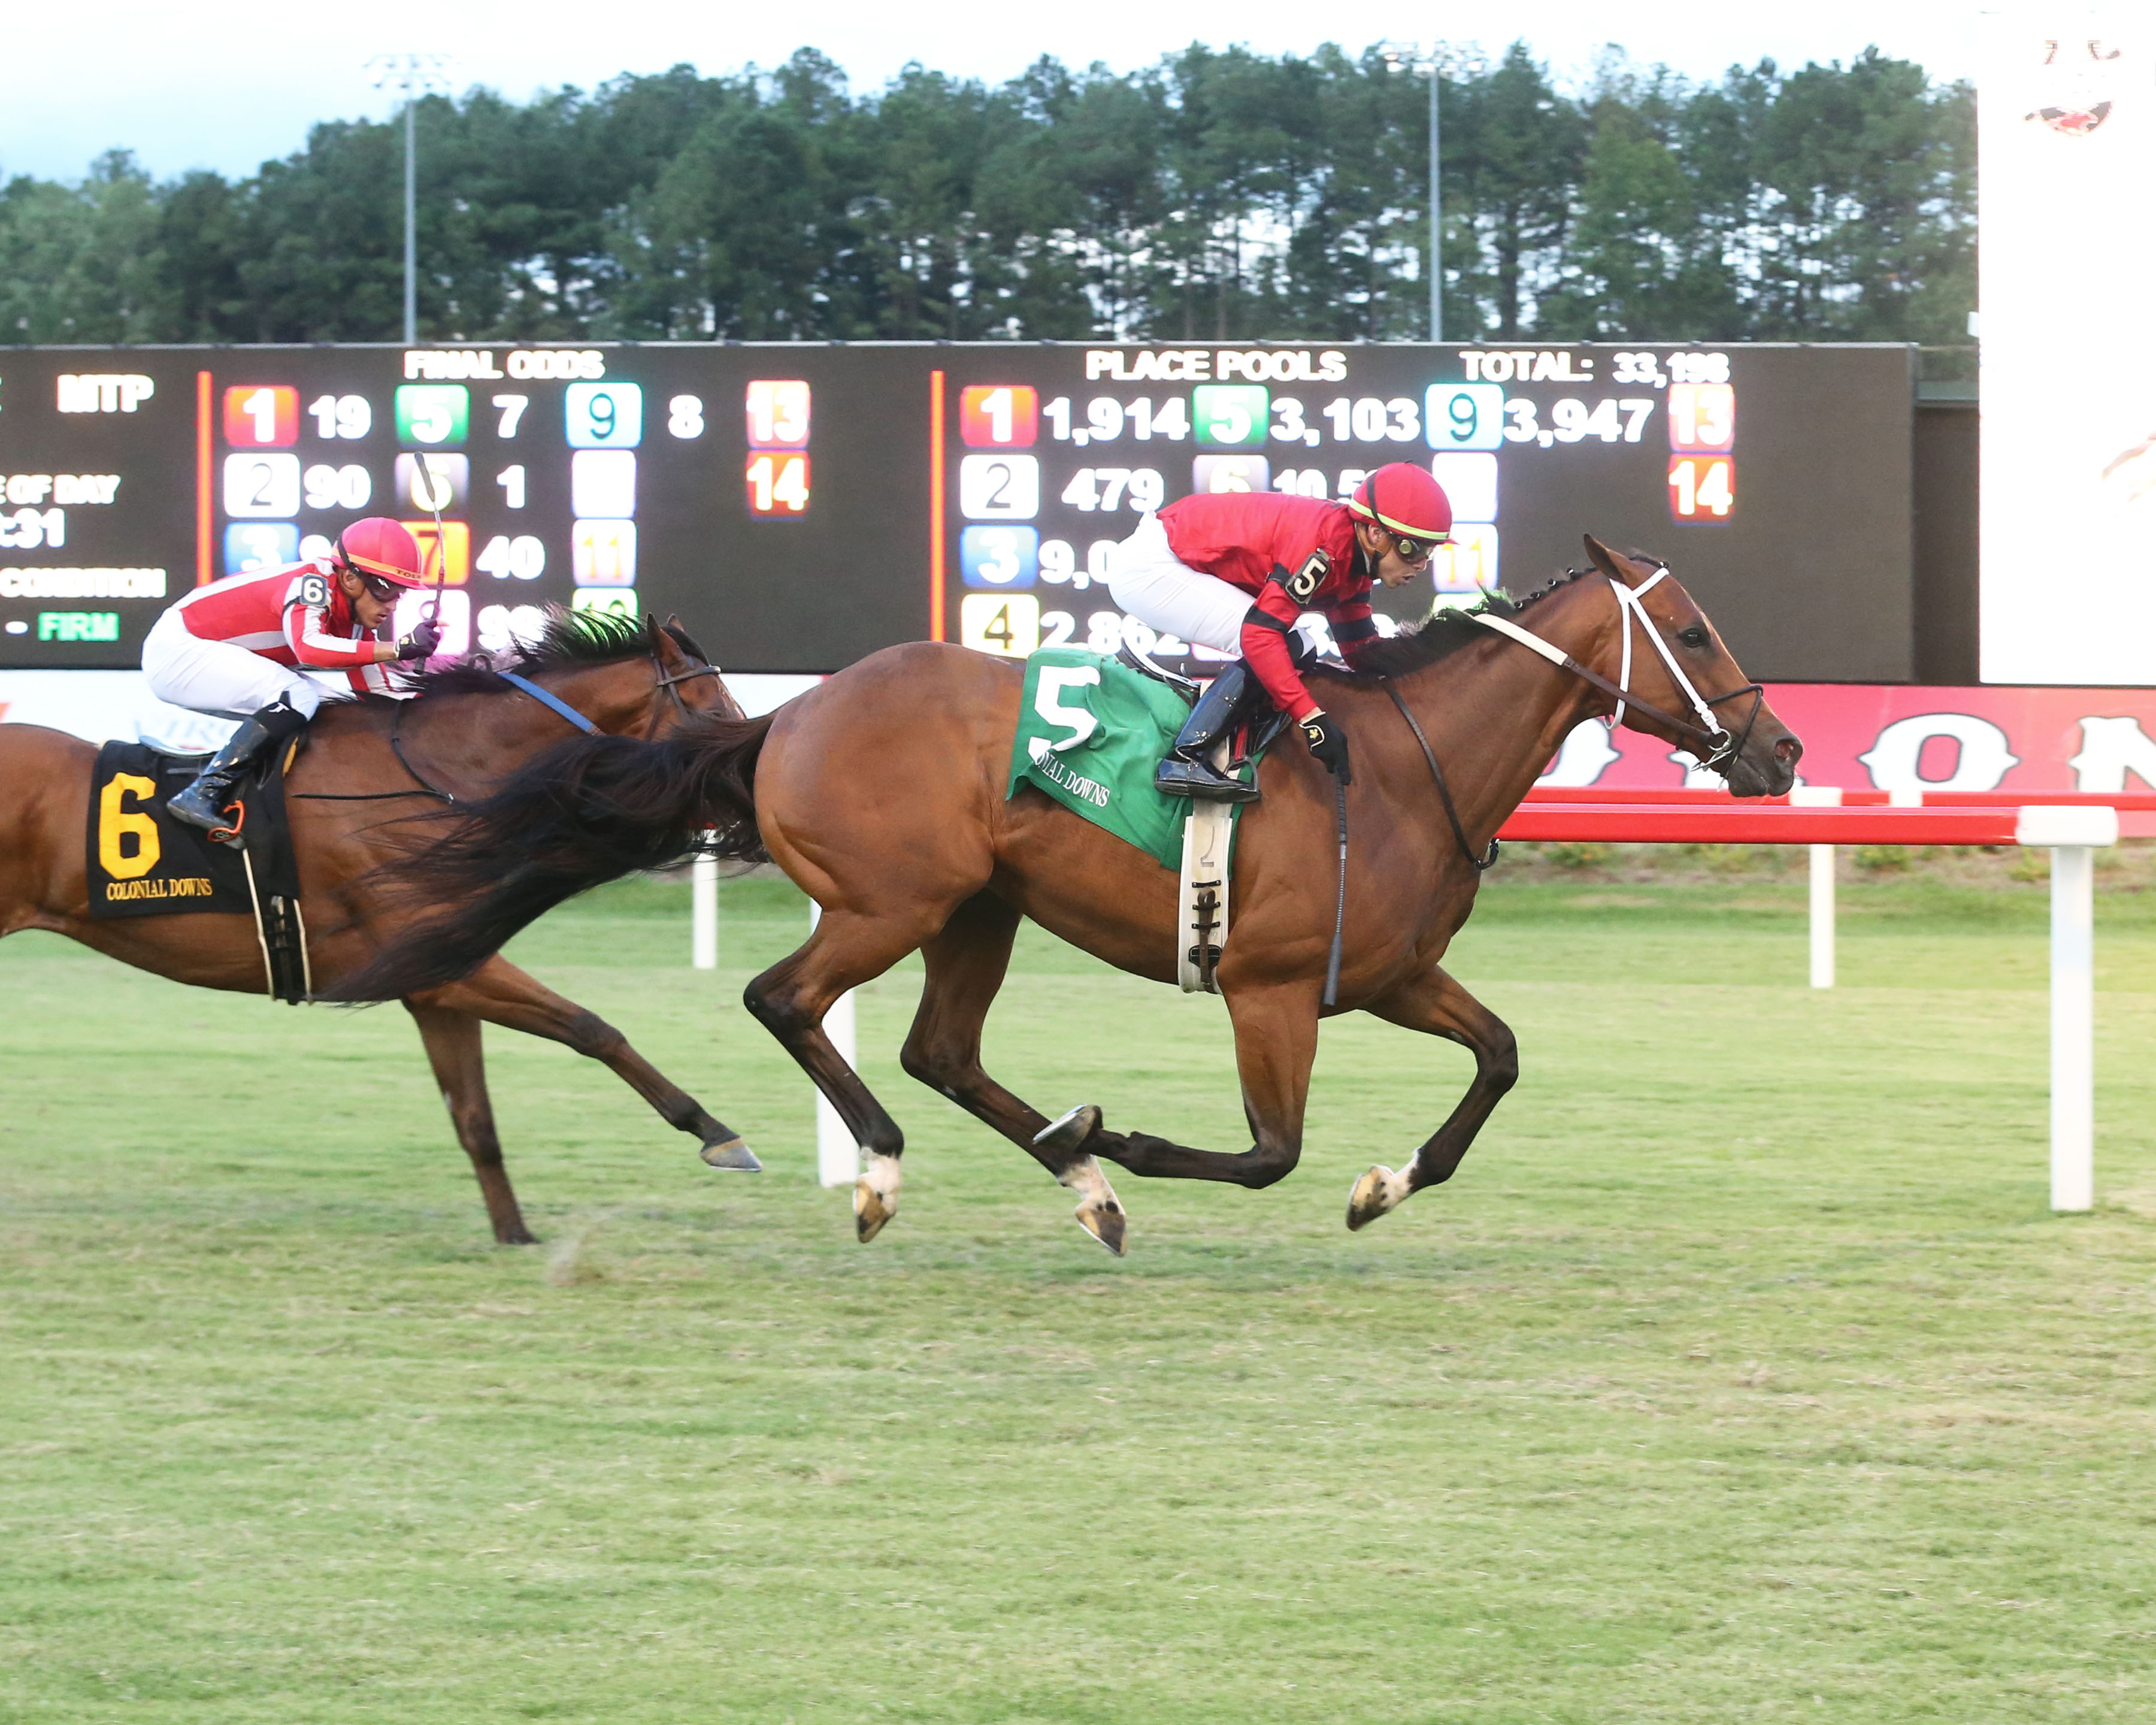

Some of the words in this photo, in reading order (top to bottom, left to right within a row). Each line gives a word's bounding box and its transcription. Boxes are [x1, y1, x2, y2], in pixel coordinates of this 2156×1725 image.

[404, 350, 504, 379] FINAL
[507, 350, 606, 379] ODDS
[1086, 350, 1211, 381] PLACE
[1216, 350, 1348, 382] POOLS
[1459, 352, 1594, 382] TOTAL:
[243, 388, 275, 442] 1
[308, 395, 372, 439] 19
[411, 389, 453, 444] 5
[492, 394, 529, 438] 7
[589, 393, 616, 440] 9
[668, 394, 705, 439] 8
[746, 389, 808, 442] 13
[980, 388, 1012, 442] 1
[1043, 397, 1191, 446] 1,914
[1209, 389, 1252, 444] 5
[1270, 397, 1421, 447] 3,103
[1448, 393, 1477, 442] 9
[1503, 398, 1654, 448] 3,947
[1669, 389, 1731, 446] 13
[5, 474, 53, 504] OF
[53, 474, 122, 504] DAY
[250, 462, 272, 506] 2
[304, 464, 372, 509] 90
[496, 464, 526, 509] 1
[747, 456, 810, 511] 14
[986, 463, 1011, 509] 2
[1061, 468, 1165, 512] 479
[1669, 461, 1733, 516] 14
[241, 525, 282, 573] 3
[417, 531, 443, 576] 7
[476, 535, 546, 580] 40
[583, 535, 620, 579] 11
[978, 529, 1020, 583] 3
[1442, 538, 1486, 585] 11
[1294, 557, 1327, 596] 5
[303, 577, 324, 603] 6
[37, 612, 120, 641] FIRM
[984, 604, 1014, 650] 4
[1028, 665, 1101, 762] 5
[1035, 750, 1066, 784] ONIAL
[1063, 770, 1111, 807] DOWNS
[99, 773, 161, 879] 6
[105, 879, 168, 901] COLONIAL
[169, 878, 213, 897] DOWNS
